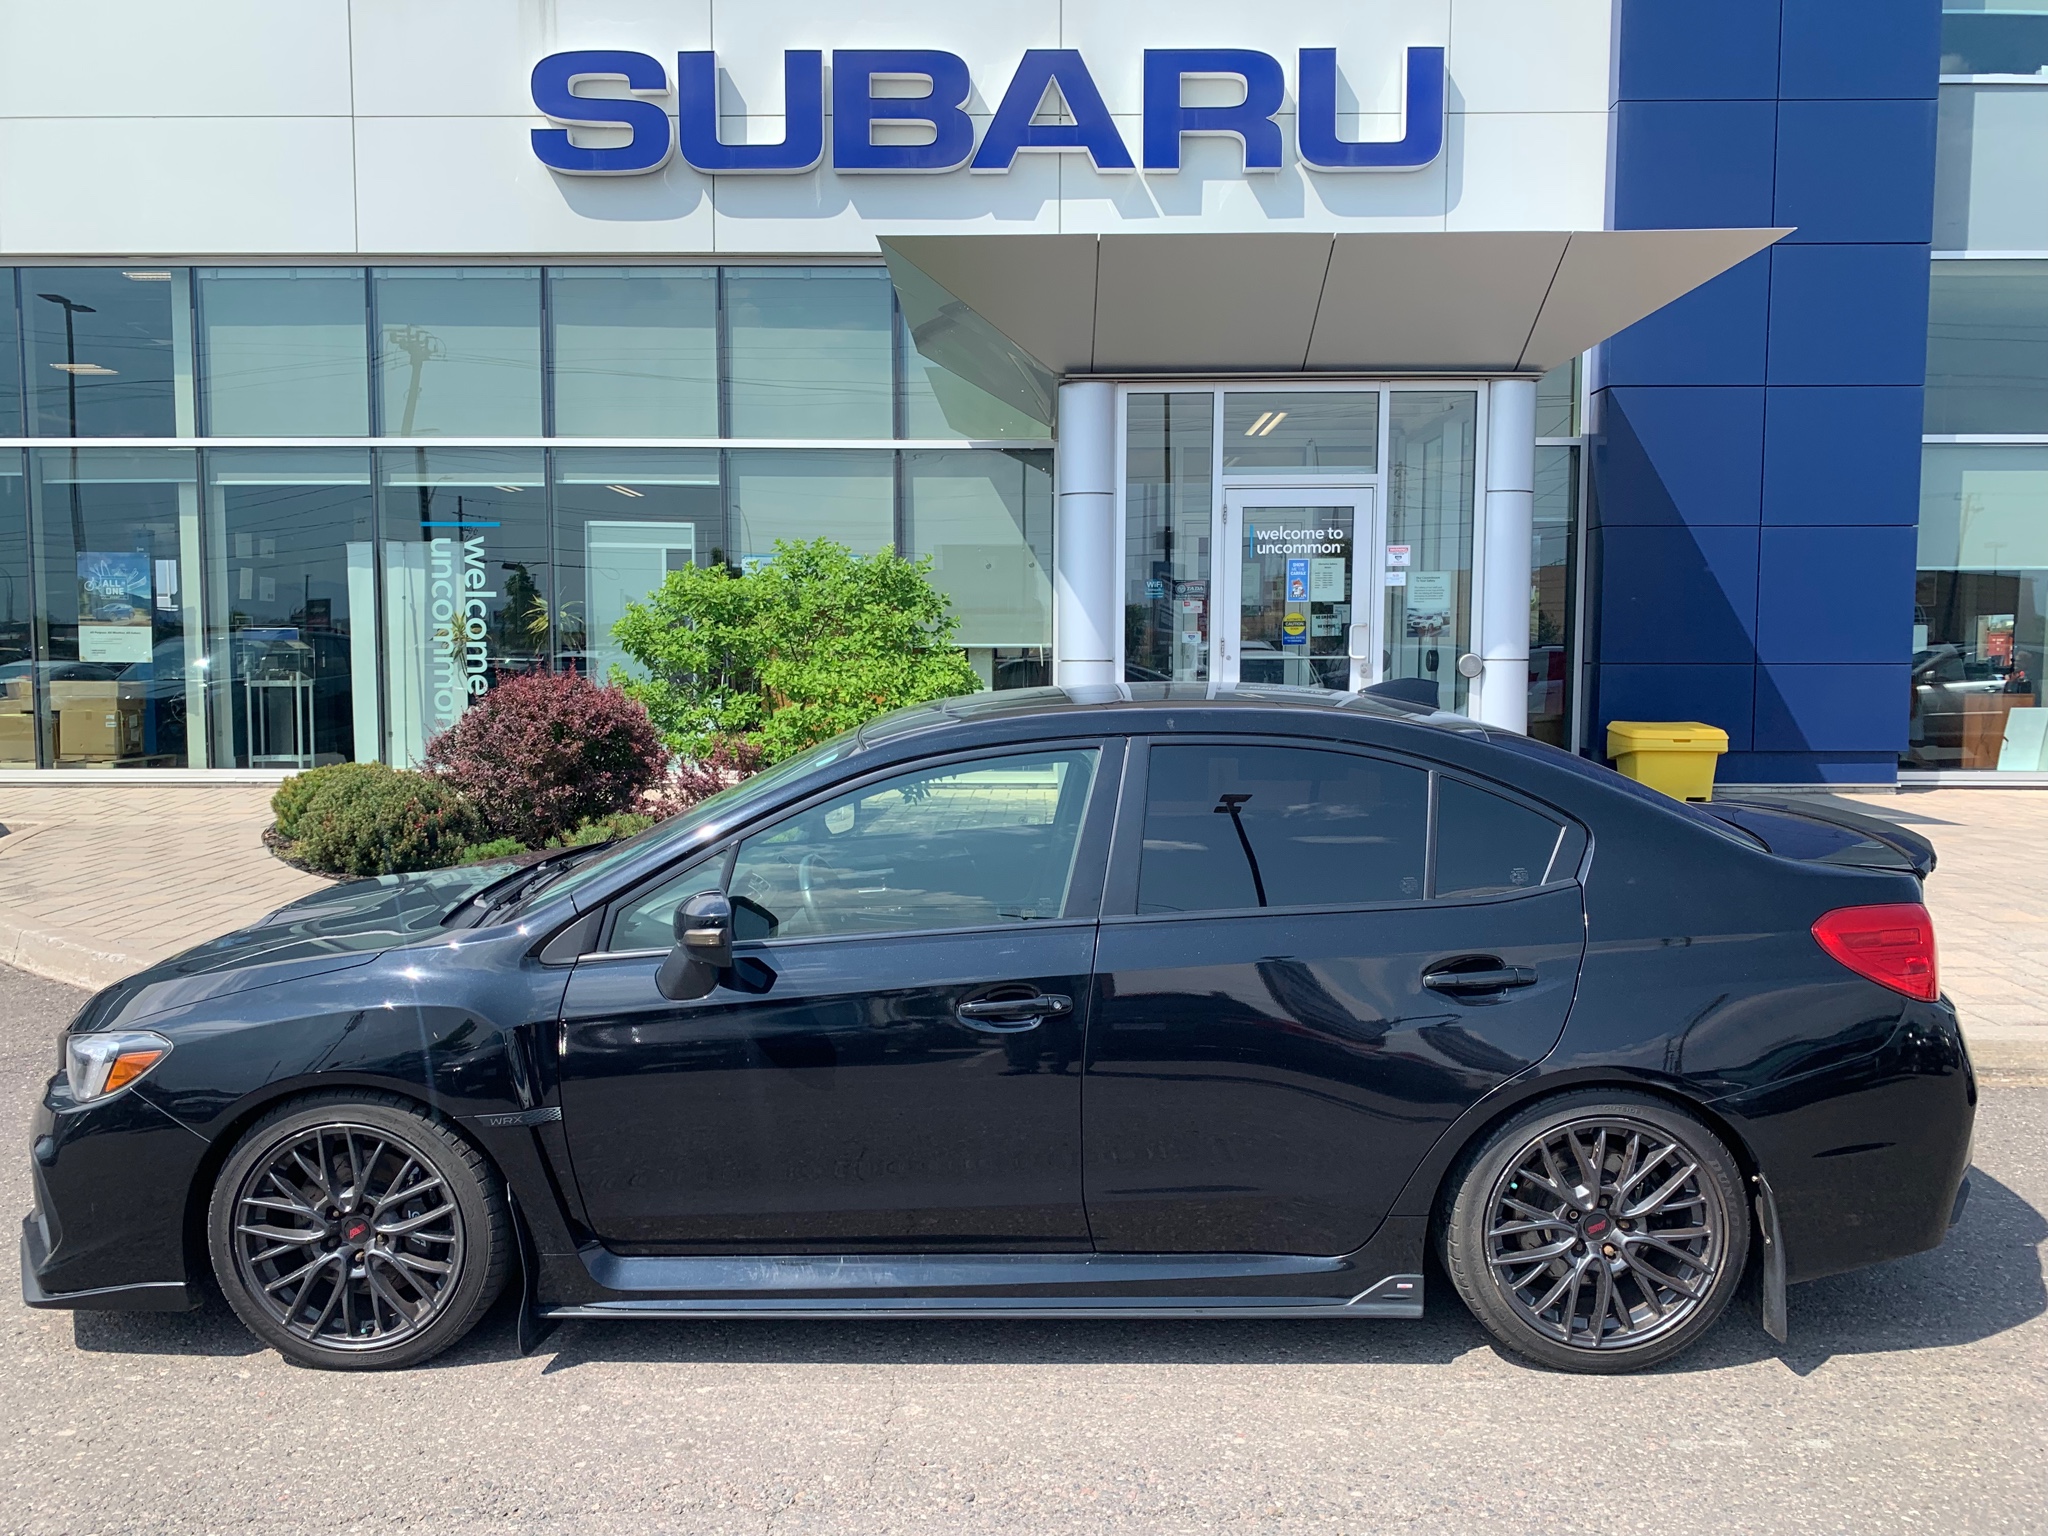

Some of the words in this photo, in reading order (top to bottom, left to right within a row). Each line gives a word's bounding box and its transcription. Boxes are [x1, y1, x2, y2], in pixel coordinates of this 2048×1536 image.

[530, 46, 1446, 174] SUBARU
[1256, 525, 1324, 540] welcome
[1327, 527, 1344, 540] to
[102, 579, 121, 588] ALL
[105, 587, 124, 596] ONE
[464, 535, 497, 696] welcome
[430, 537, 454, 731] uncommon
[489, 1115, 523, 1126] WRX
